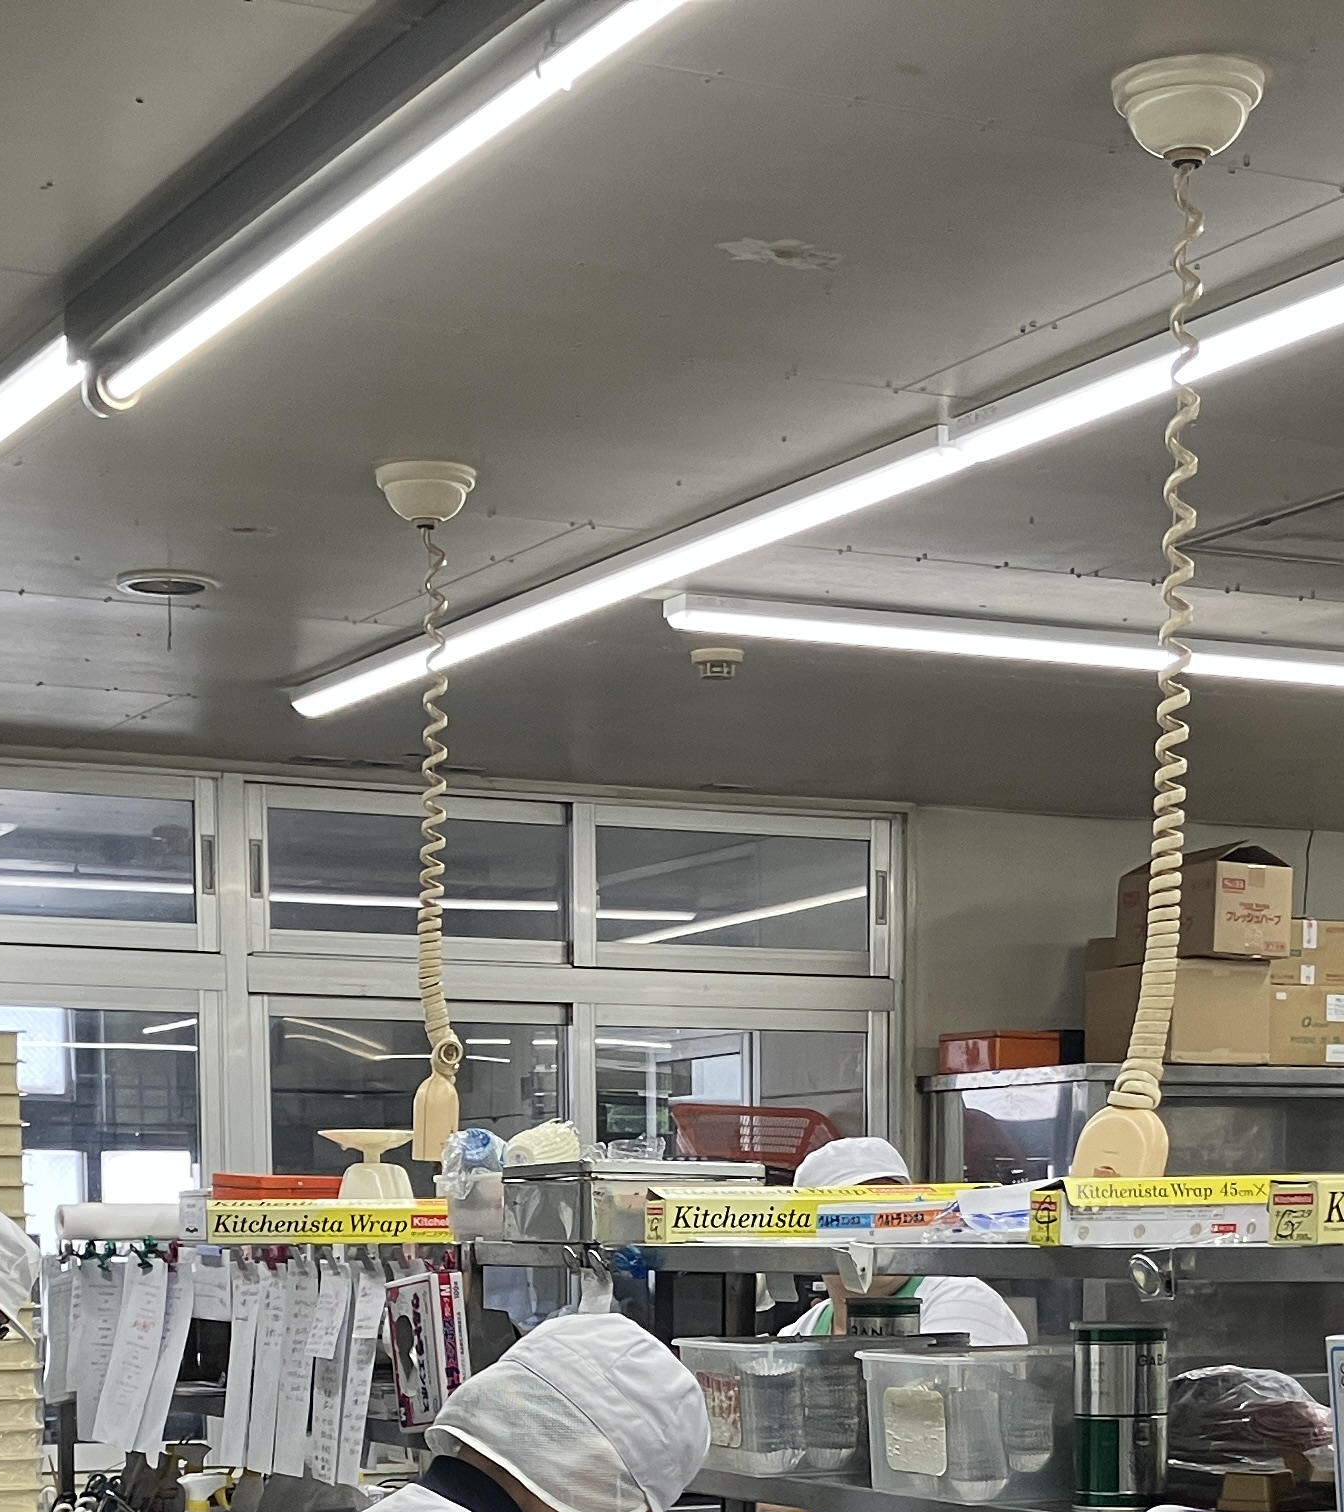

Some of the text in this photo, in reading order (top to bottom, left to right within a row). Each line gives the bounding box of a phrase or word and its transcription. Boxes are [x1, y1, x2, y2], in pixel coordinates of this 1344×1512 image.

[1076, 1183, 1167, 1200] Kitchenista
[1171, 1183, 1213, 1201] Wrap
[214, 1214, 408, 1237] Kitchenista Wrap
[671, 1205, 811, 1229] Kitchenista
